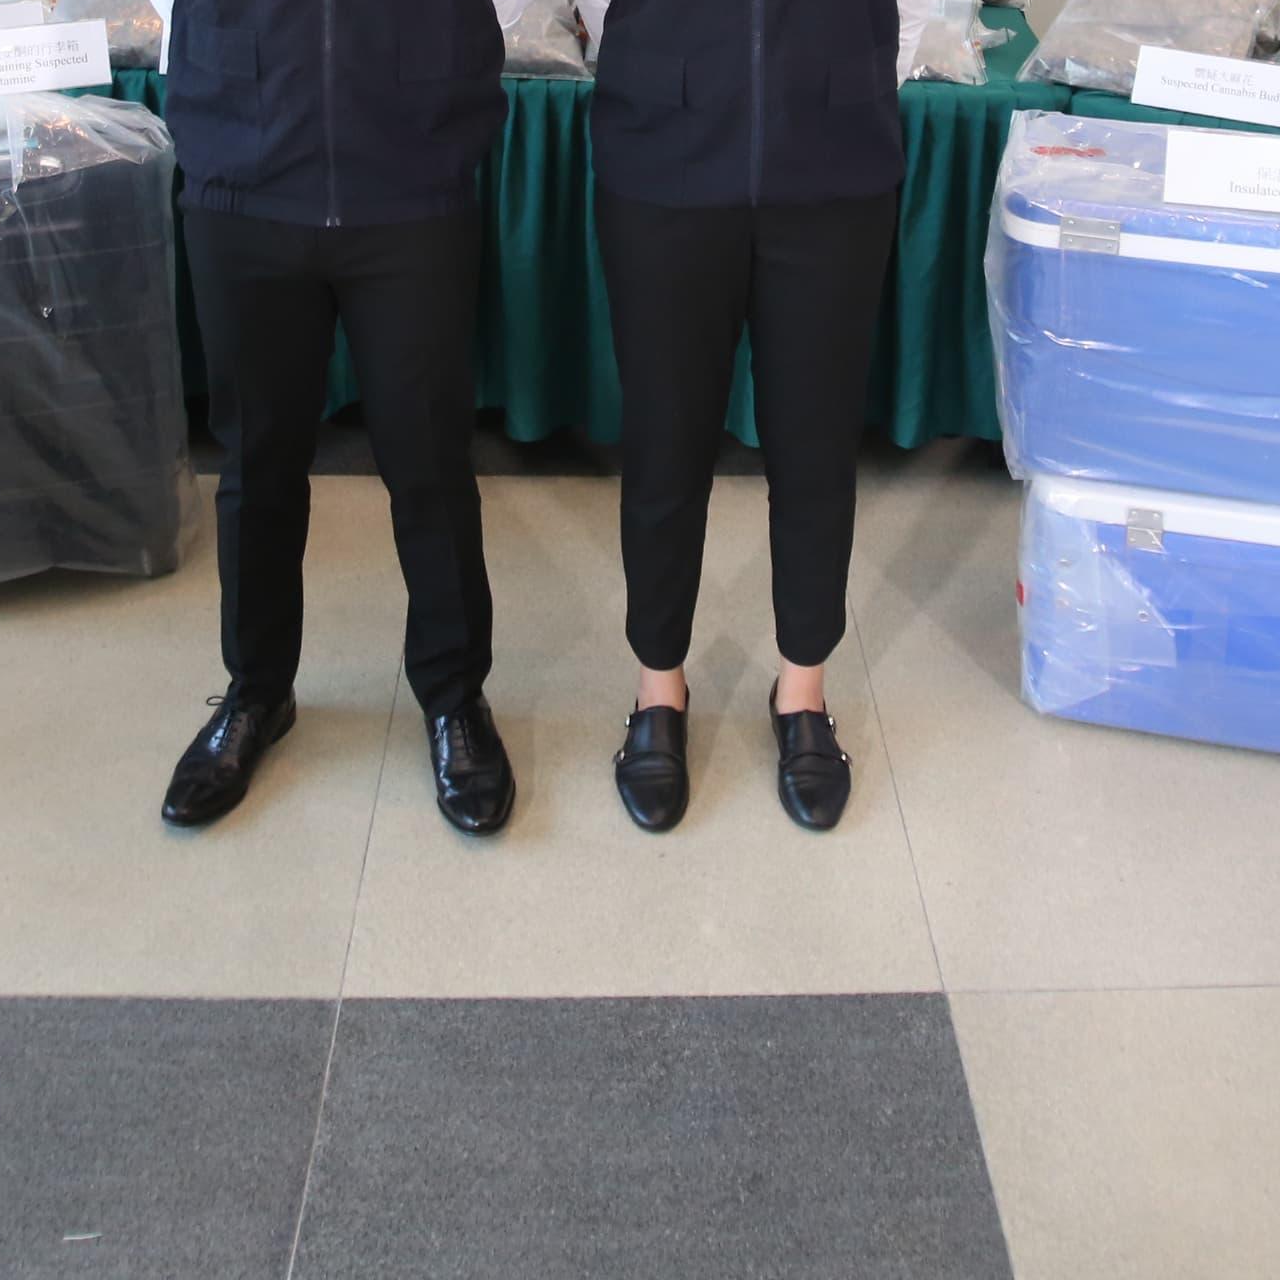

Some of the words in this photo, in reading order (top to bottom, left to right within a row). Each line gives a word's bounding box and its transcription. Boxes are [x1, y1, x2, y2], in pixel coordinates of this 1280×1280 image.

[34, 53, 88, 69] Suspected
[1160, 75, 1208, 94] Suspected
[1211, 83, 1256, 100] Cannabis
